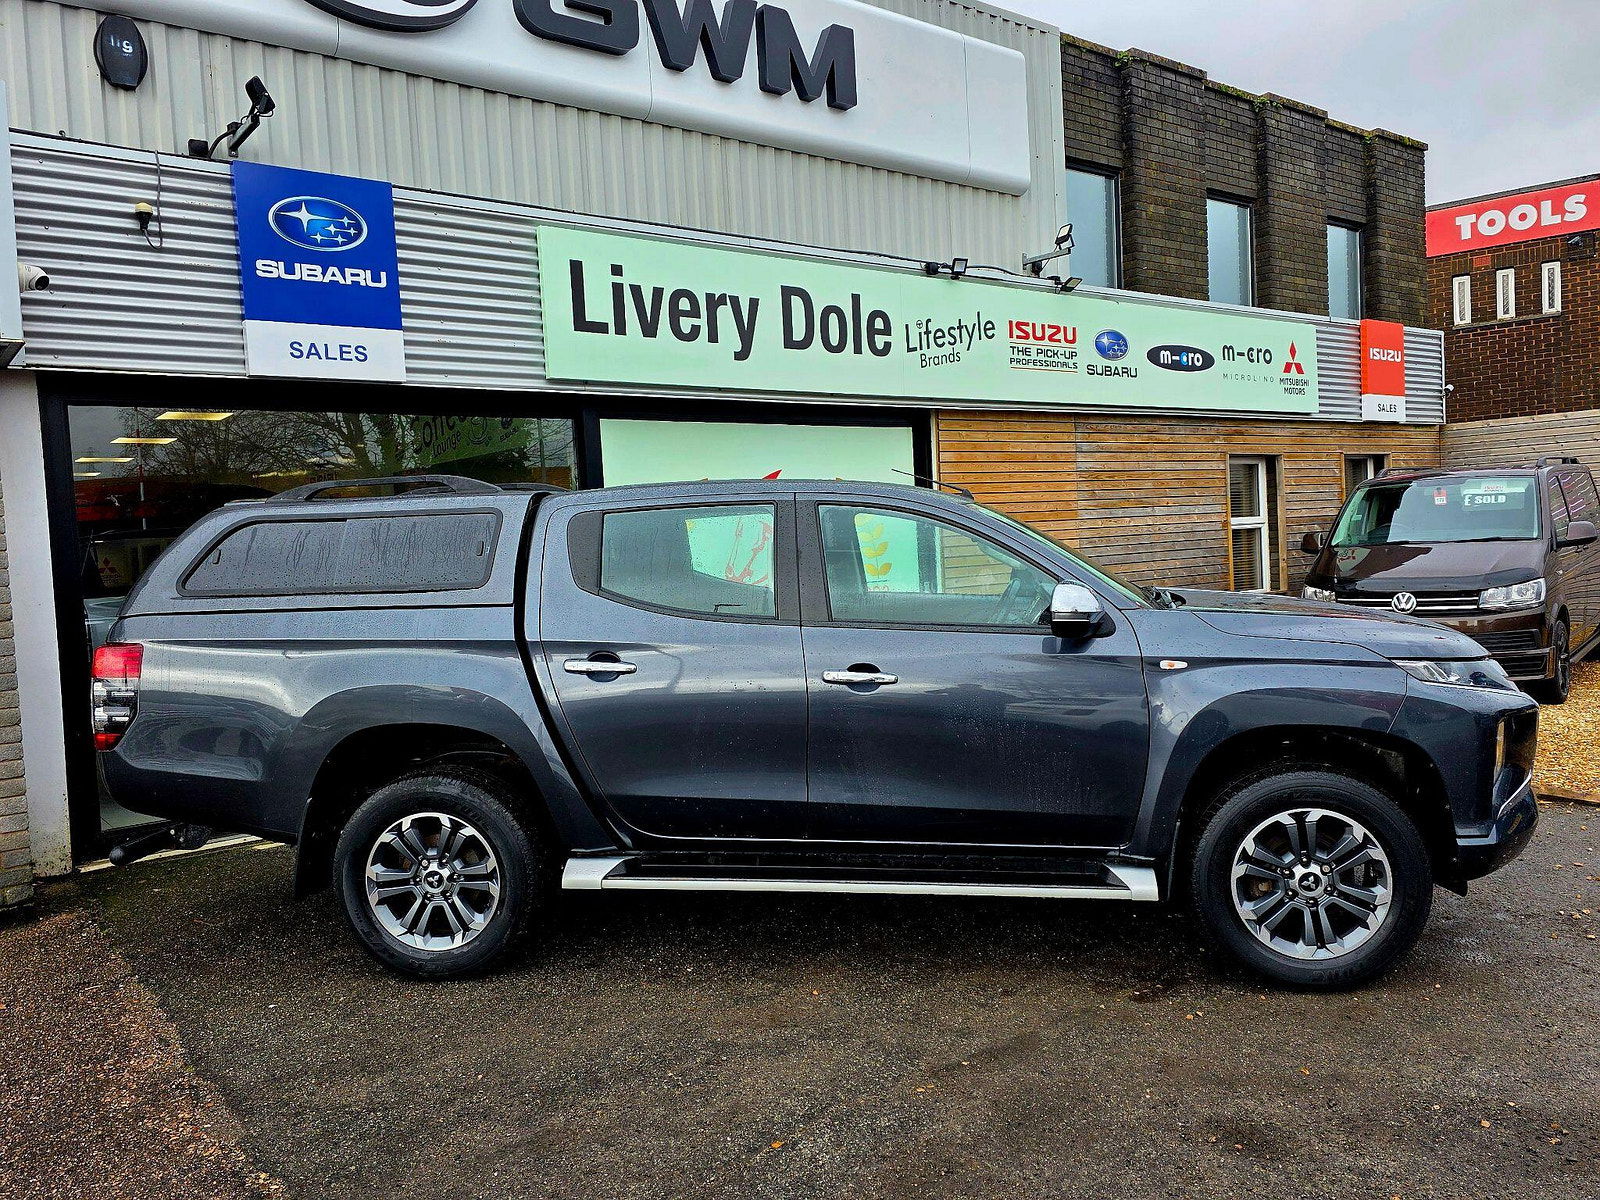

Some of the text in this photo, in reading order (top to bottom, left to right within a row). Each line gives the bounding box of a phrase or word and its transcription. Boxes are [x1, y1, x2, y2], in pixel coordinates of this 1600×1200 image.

[1455, 194, 1588, 241] TOOLS
[255, 259, 387, 289] SUBARU
[569, 259, 892, 361] Livery Dole
[905, 311, 996, 353] Lifestyle
[1008, 320, 1077, 344] ISUZU
[289, 340, 368, 363] SALES
[1010, 346, 1078, 360] THE PICK-UP
[1369, 348, 1402, 363] ISUZU
[920, 349, 961, 369] Brands
[1009, 357, 1078, 370] PROFESSIONALS
[1086, 364, 1138, 378] SUBARU
[1222, 373, 1275, 383] MICROLINO
[1279, 378, 1310, 387] MITSUBISHI
[1283, 387, 1306, 396] MOTORS
[1377, 403, 1397, 413] SALES
[1474, 494, 1506, 505] SOLD
